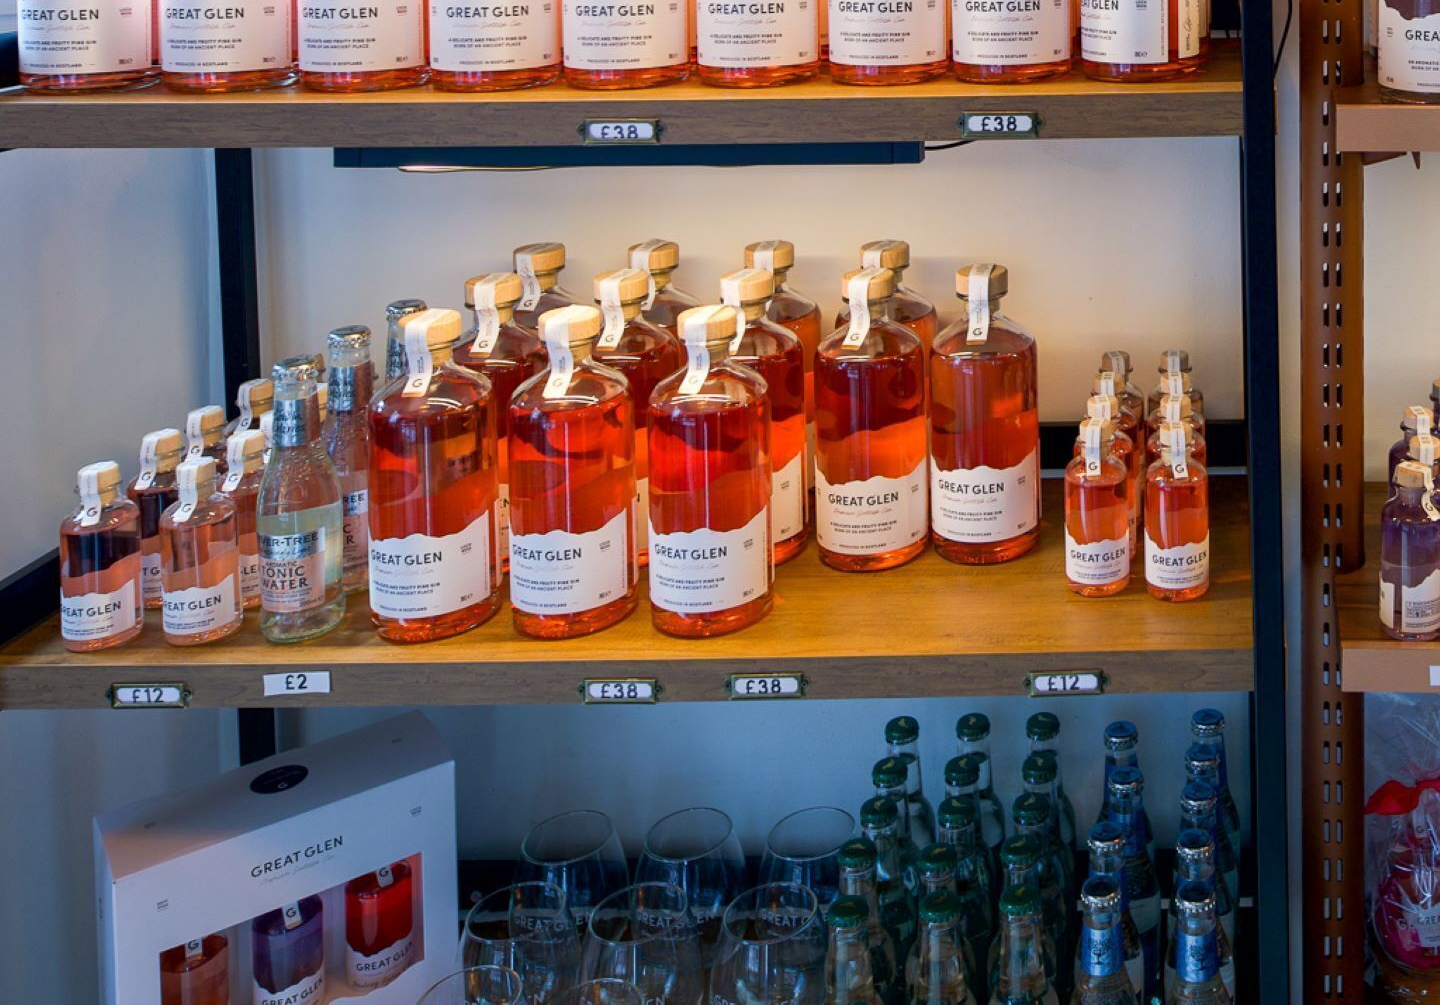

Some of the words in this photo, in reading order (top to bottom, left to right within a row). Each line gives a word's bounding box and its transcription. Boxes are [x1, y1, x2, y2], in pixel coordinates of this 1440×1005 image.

[58, 8, 100, 21] GLEN
[166, 7, 202, 20] GREAT
[204, 7, 245, 20] GLEN
[303, 6, 337, 20] GREAT
[339, 6, 378, 19] GLEN
[446, 6, 489, 18] GREAT
[492, 5, 529, 18] GLEN
[575, 5, 614, 17] GREAT
[617, 4, 655, 17] GLEN
[708, 2, 746, 15] GREAT
[748, 2, 785, 15] GLEN
[838, 1, 875, 13] GREAT
[877, 1, 913, 13] GLEN
[965, 0, 1003, 13] GREAT
[1005, 0, 1041, 12] GLEN
[601, 123, 640, 139] £38
[980, 115, 1018, 132] £38
[939, 479, 970, 493] GREAT
[972, 482, 1005, 495] GLEN
[828, 493, 864, 507] GREAT
[866, 492, 899, 506] GLEN
[371, 549, 402, 566] GREAT
[404, 550, 443, 566] GLEN
[512, 544, 542, 561] GREAT
[544, 547, 582, 562] GLEN
[654, 543, 689, 559] GREAT
[690, 546, 728, 561] GLEN
[1070, 549, 1101, 563] GREAT
[1101, 547, 1126, 562] GLEN
[1152, 554, 1184, 567] GREAT
[1186, 550, 1207, 565] GLEN
[86, 600, 122, 617] GLEN
[188, 594, 222, 610] GLEN
[284, 673, 309, 691] £2
[745, 679, 782, 695] £38
[1047, 675, 1081, 692] £12
[132, 688, 165, 703] £12
[600, 683, 639, 699] £38
[250, 849, 302, 879] GREAT
[304, 835, 344, 859] GLEN
[356, 958, 393, 972] GREAT
